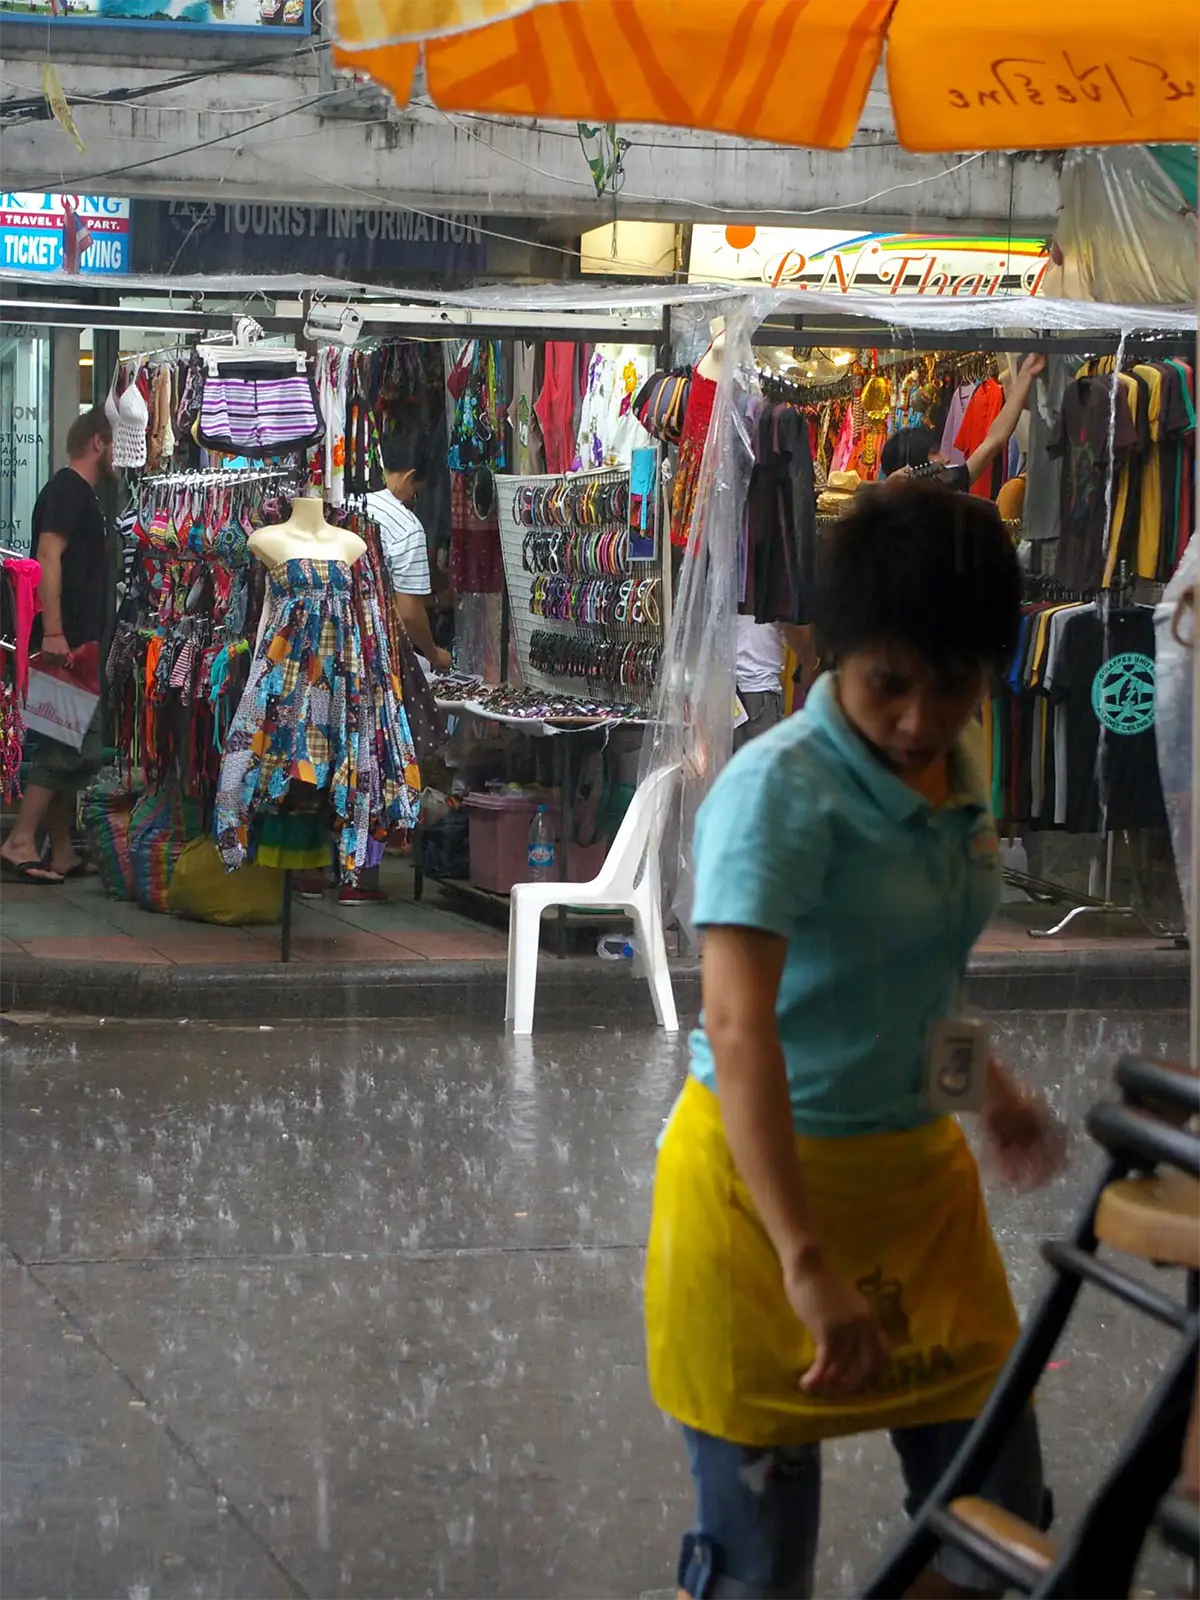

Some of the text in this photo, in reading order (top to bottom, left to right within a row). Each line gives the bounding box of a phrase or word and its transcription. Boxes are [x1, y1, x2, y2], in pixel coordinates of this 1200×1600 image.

[5, 215, 52, 226] TRAVEL
[87, 220, 120, 230] PART.
[223, 196, 482, 244] TOURIST INFORMATION
[4, 235, 58, 265] TICKET
[16, 434, 43, 444] VISA
